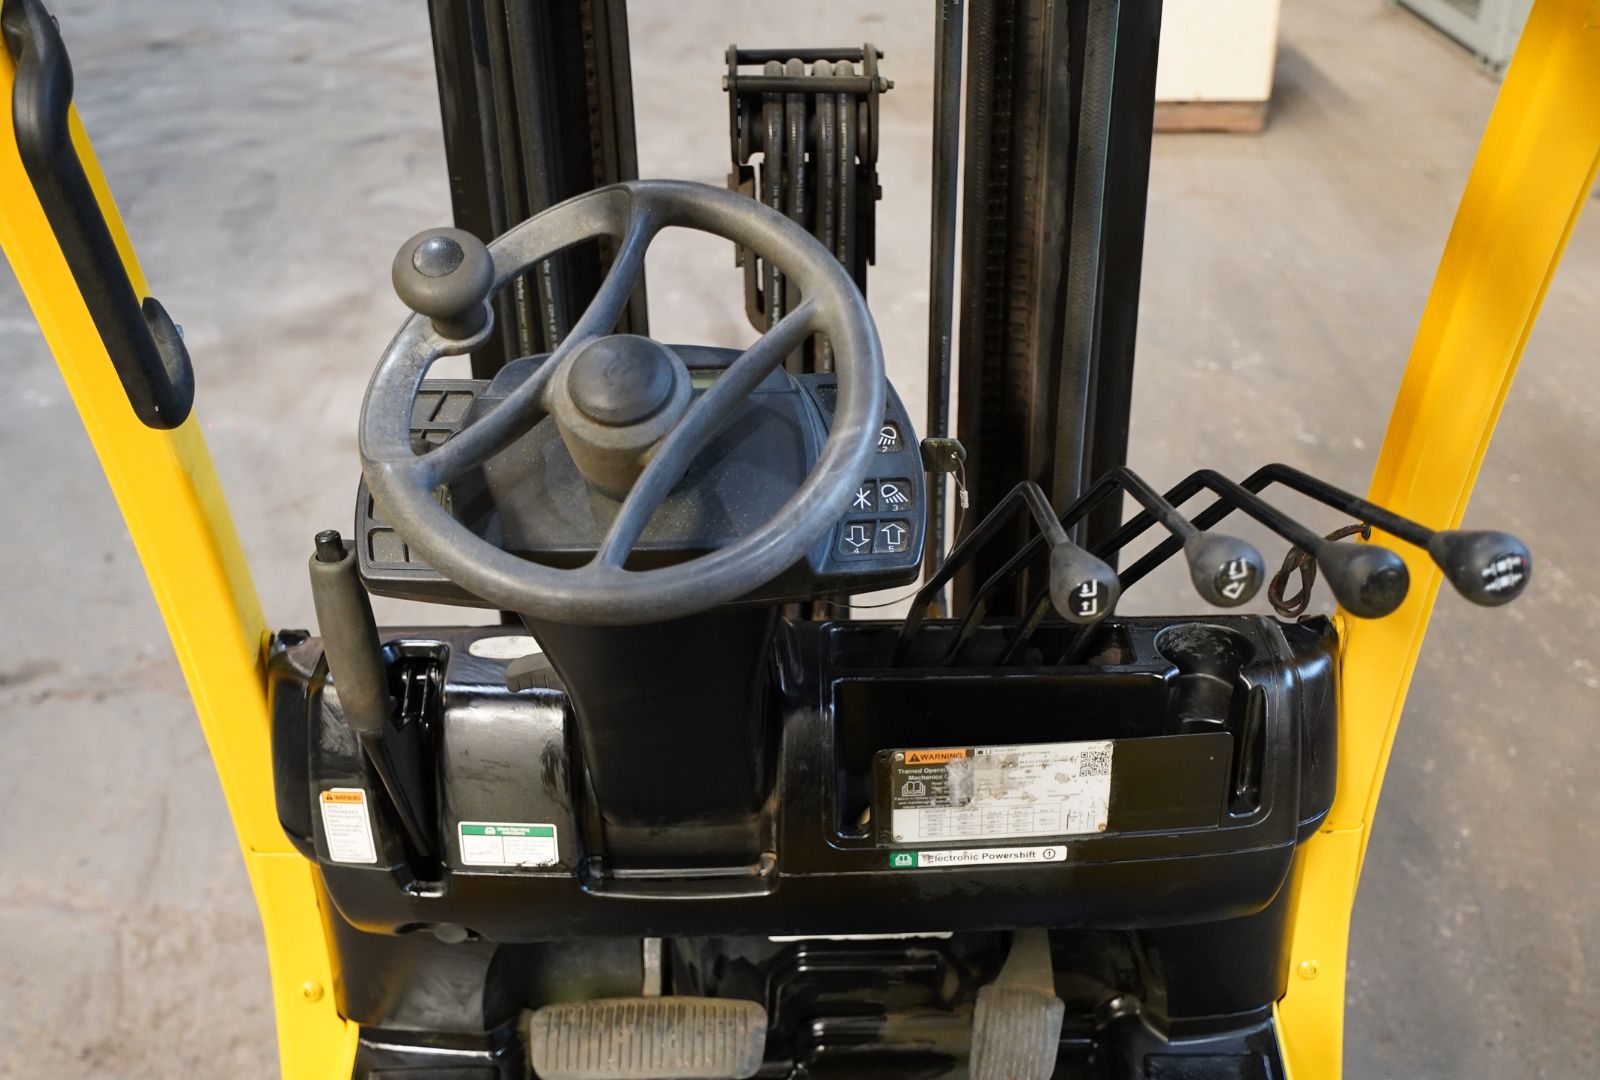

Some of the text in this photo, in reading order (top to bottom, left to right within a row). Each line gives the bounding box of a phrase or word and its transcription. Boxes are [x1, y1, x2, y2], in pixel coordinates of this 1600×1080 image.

[920, 752, 963, 760] WARNING
[927, 852, 979, 863] Electronic
[982, 850, 1037, 860] Powershift
